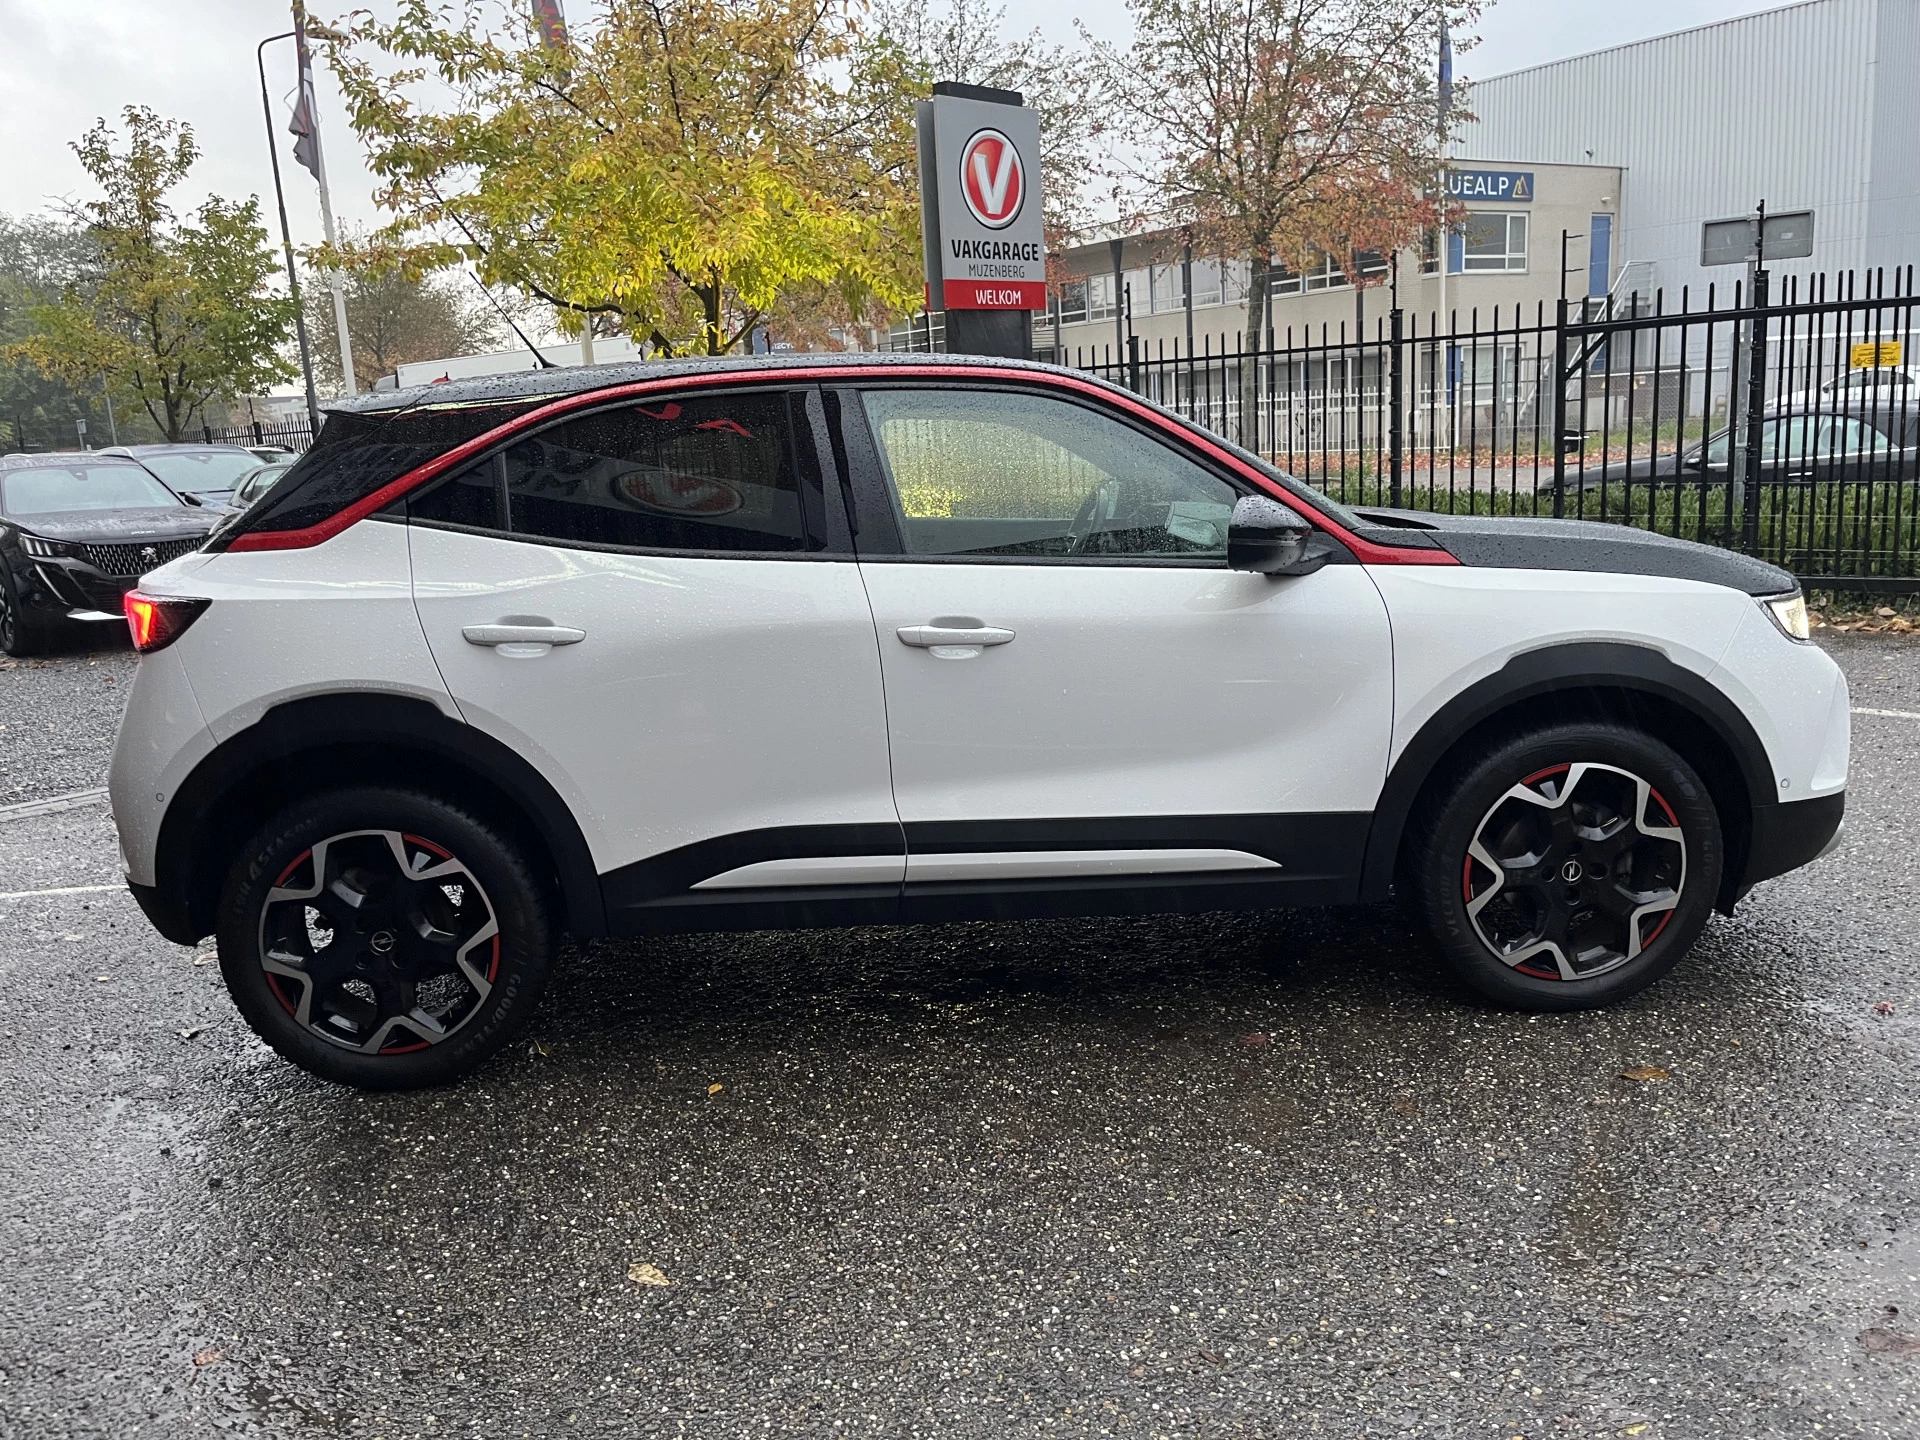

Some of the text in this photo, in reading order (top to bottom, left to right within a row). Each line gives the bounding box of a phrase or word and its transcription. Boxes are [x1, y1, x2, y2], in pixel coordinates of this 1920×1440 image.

[951, 239, 1039, 261] VAKGARAGE
[968, 264, 1025, 278] MUZENBERG
[975, 289, 1022, 305] WELKOM
